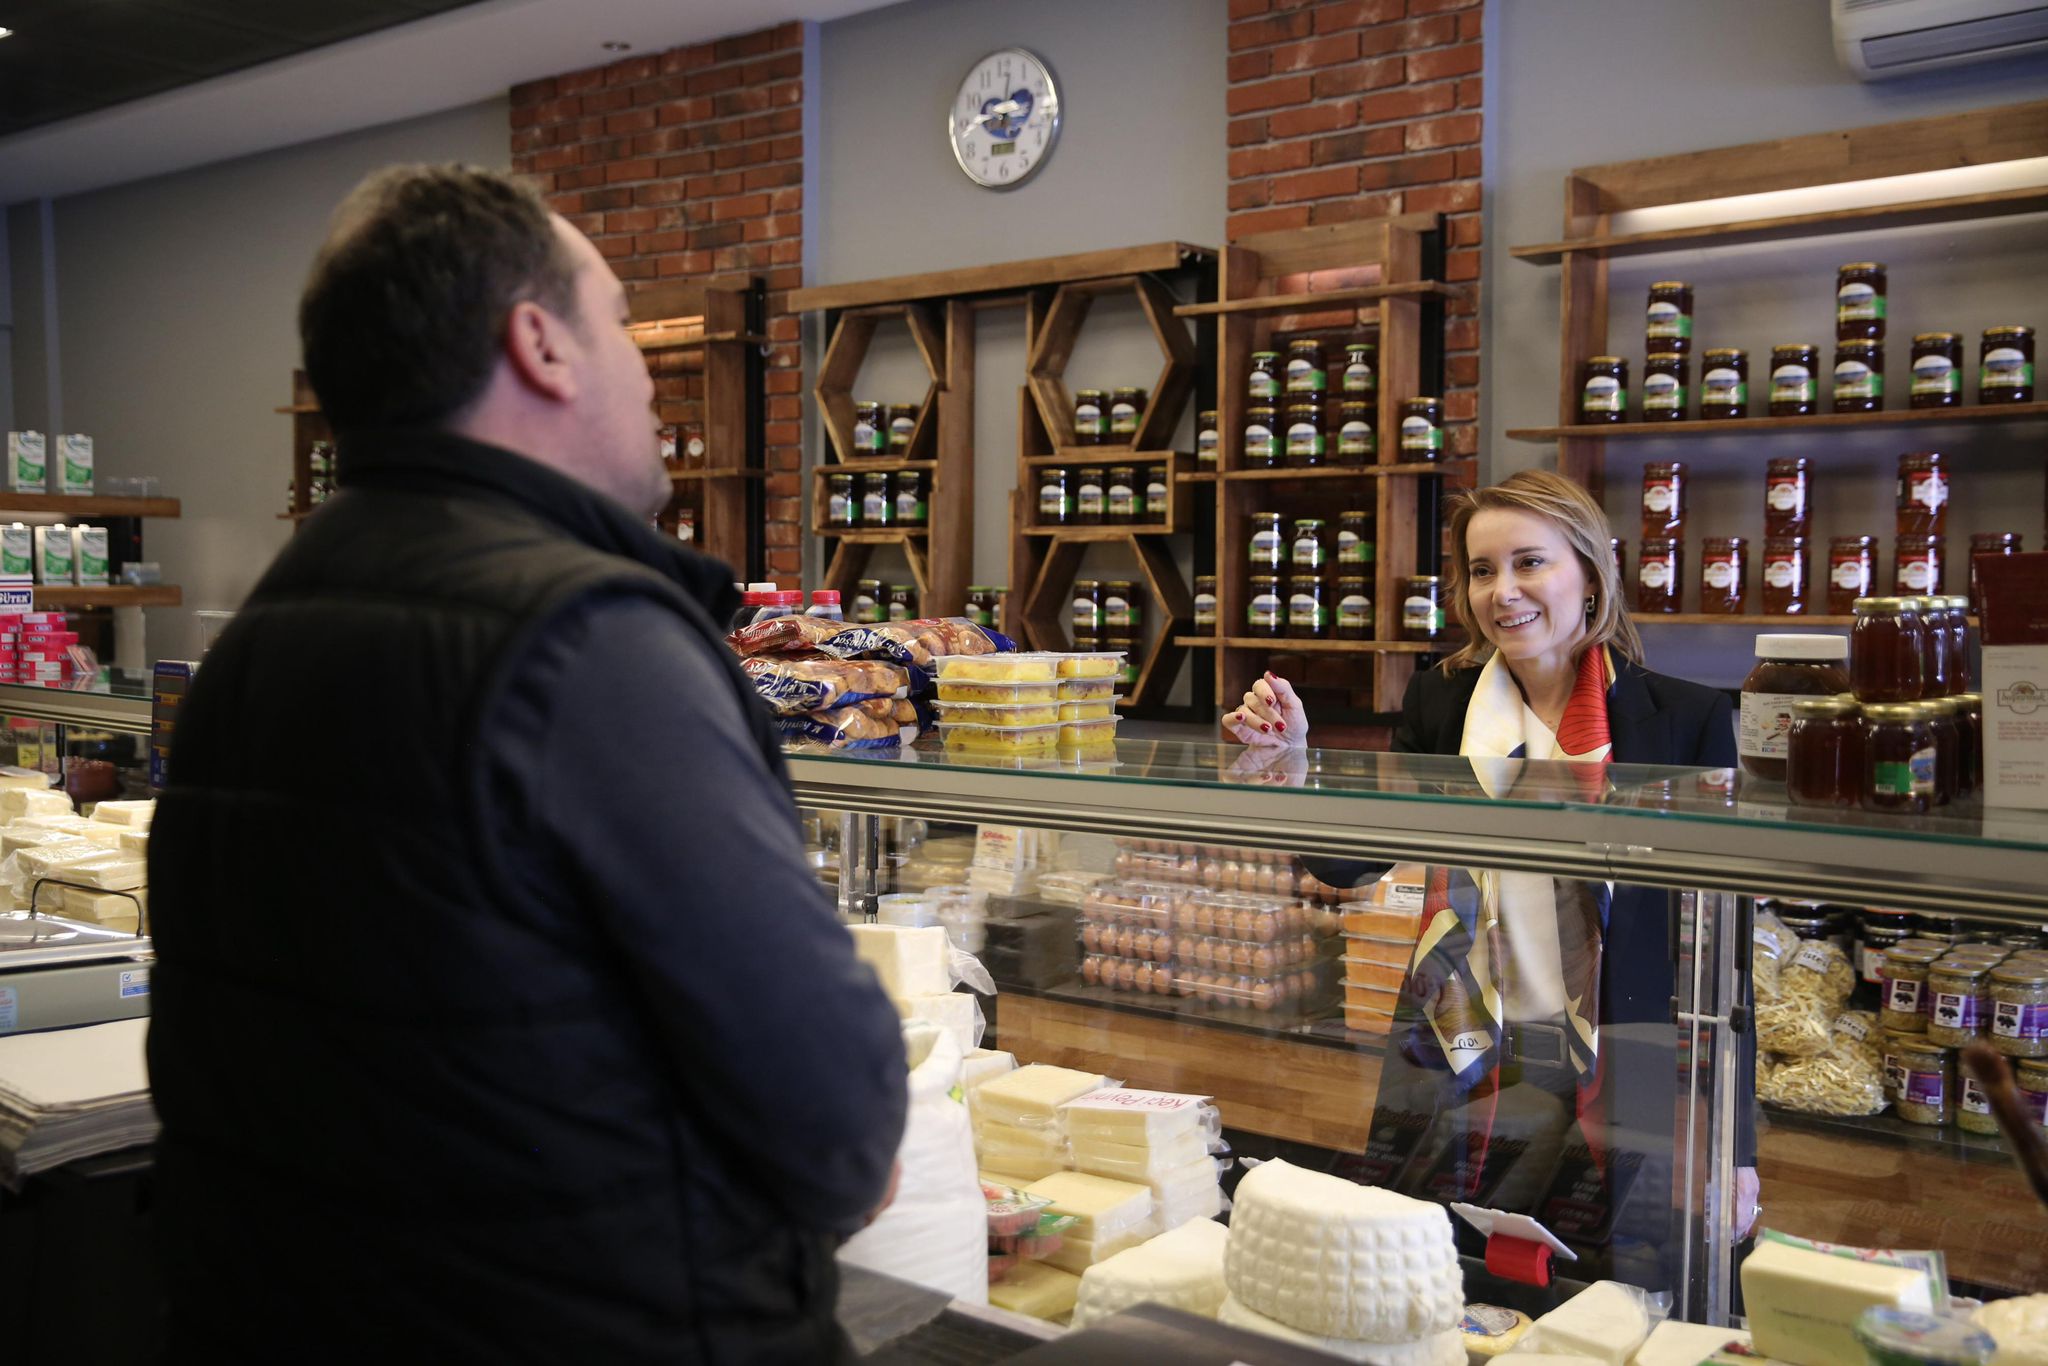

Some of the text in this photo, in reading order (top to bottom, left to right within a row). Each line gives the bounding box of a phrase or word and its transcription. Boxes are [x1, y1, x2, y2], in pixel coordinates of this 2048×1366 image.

[997, 58, 1011, 78] 12
[1021, 63, 1027, 80] 1
[980, 70, 992, 89] 11
[966, 92, 982, 110] 10
[999, 161, 1009, 178] 6
